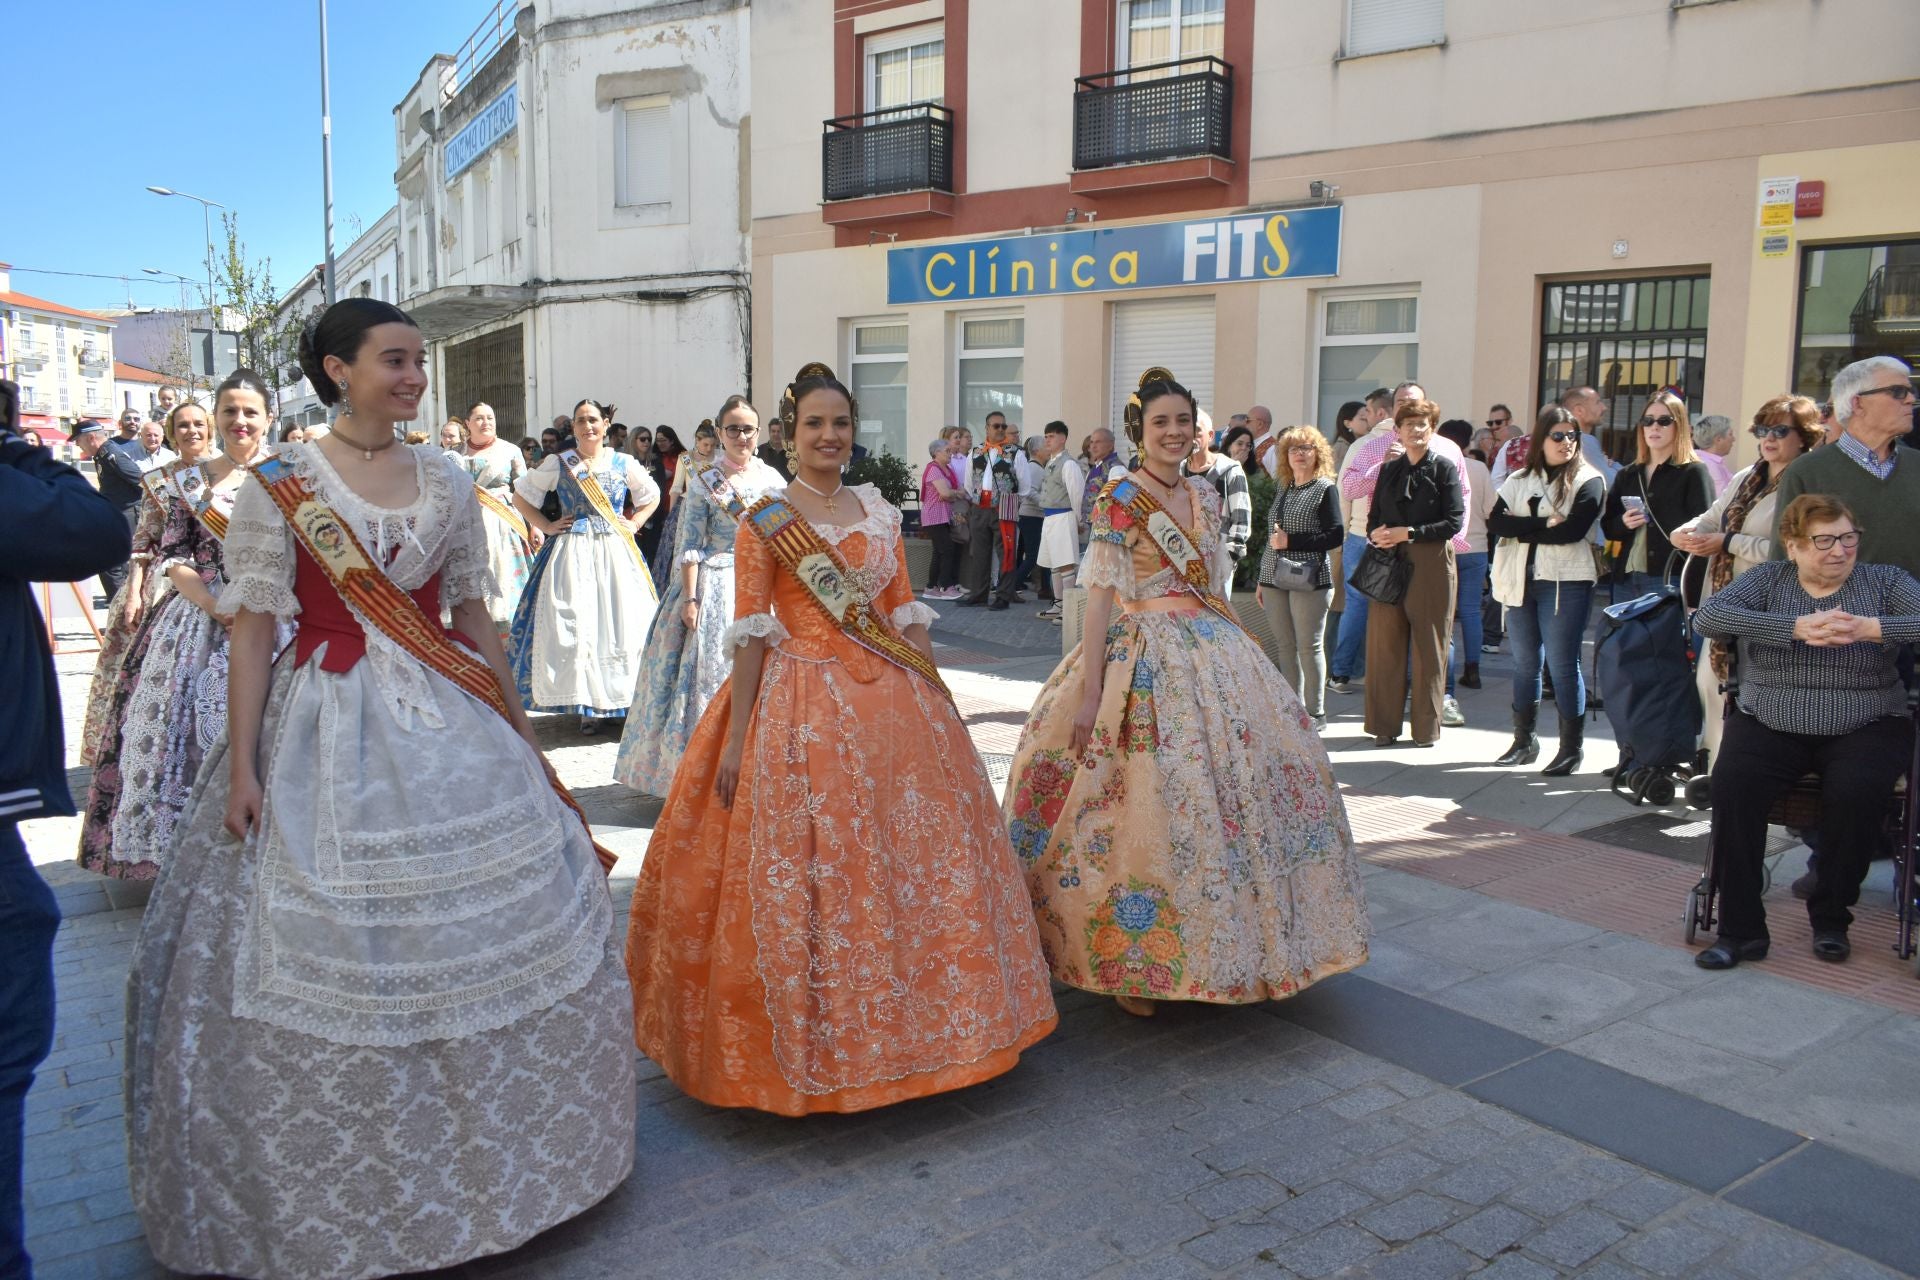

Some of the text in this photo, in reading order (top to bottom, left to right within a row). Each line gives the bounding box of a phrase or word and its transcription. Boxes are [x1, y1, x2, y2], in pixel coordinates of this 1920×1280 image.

[448, 94, 514, 173] CINEMA OTERO
[925, 214, 1290, 298] Clínica FITS
